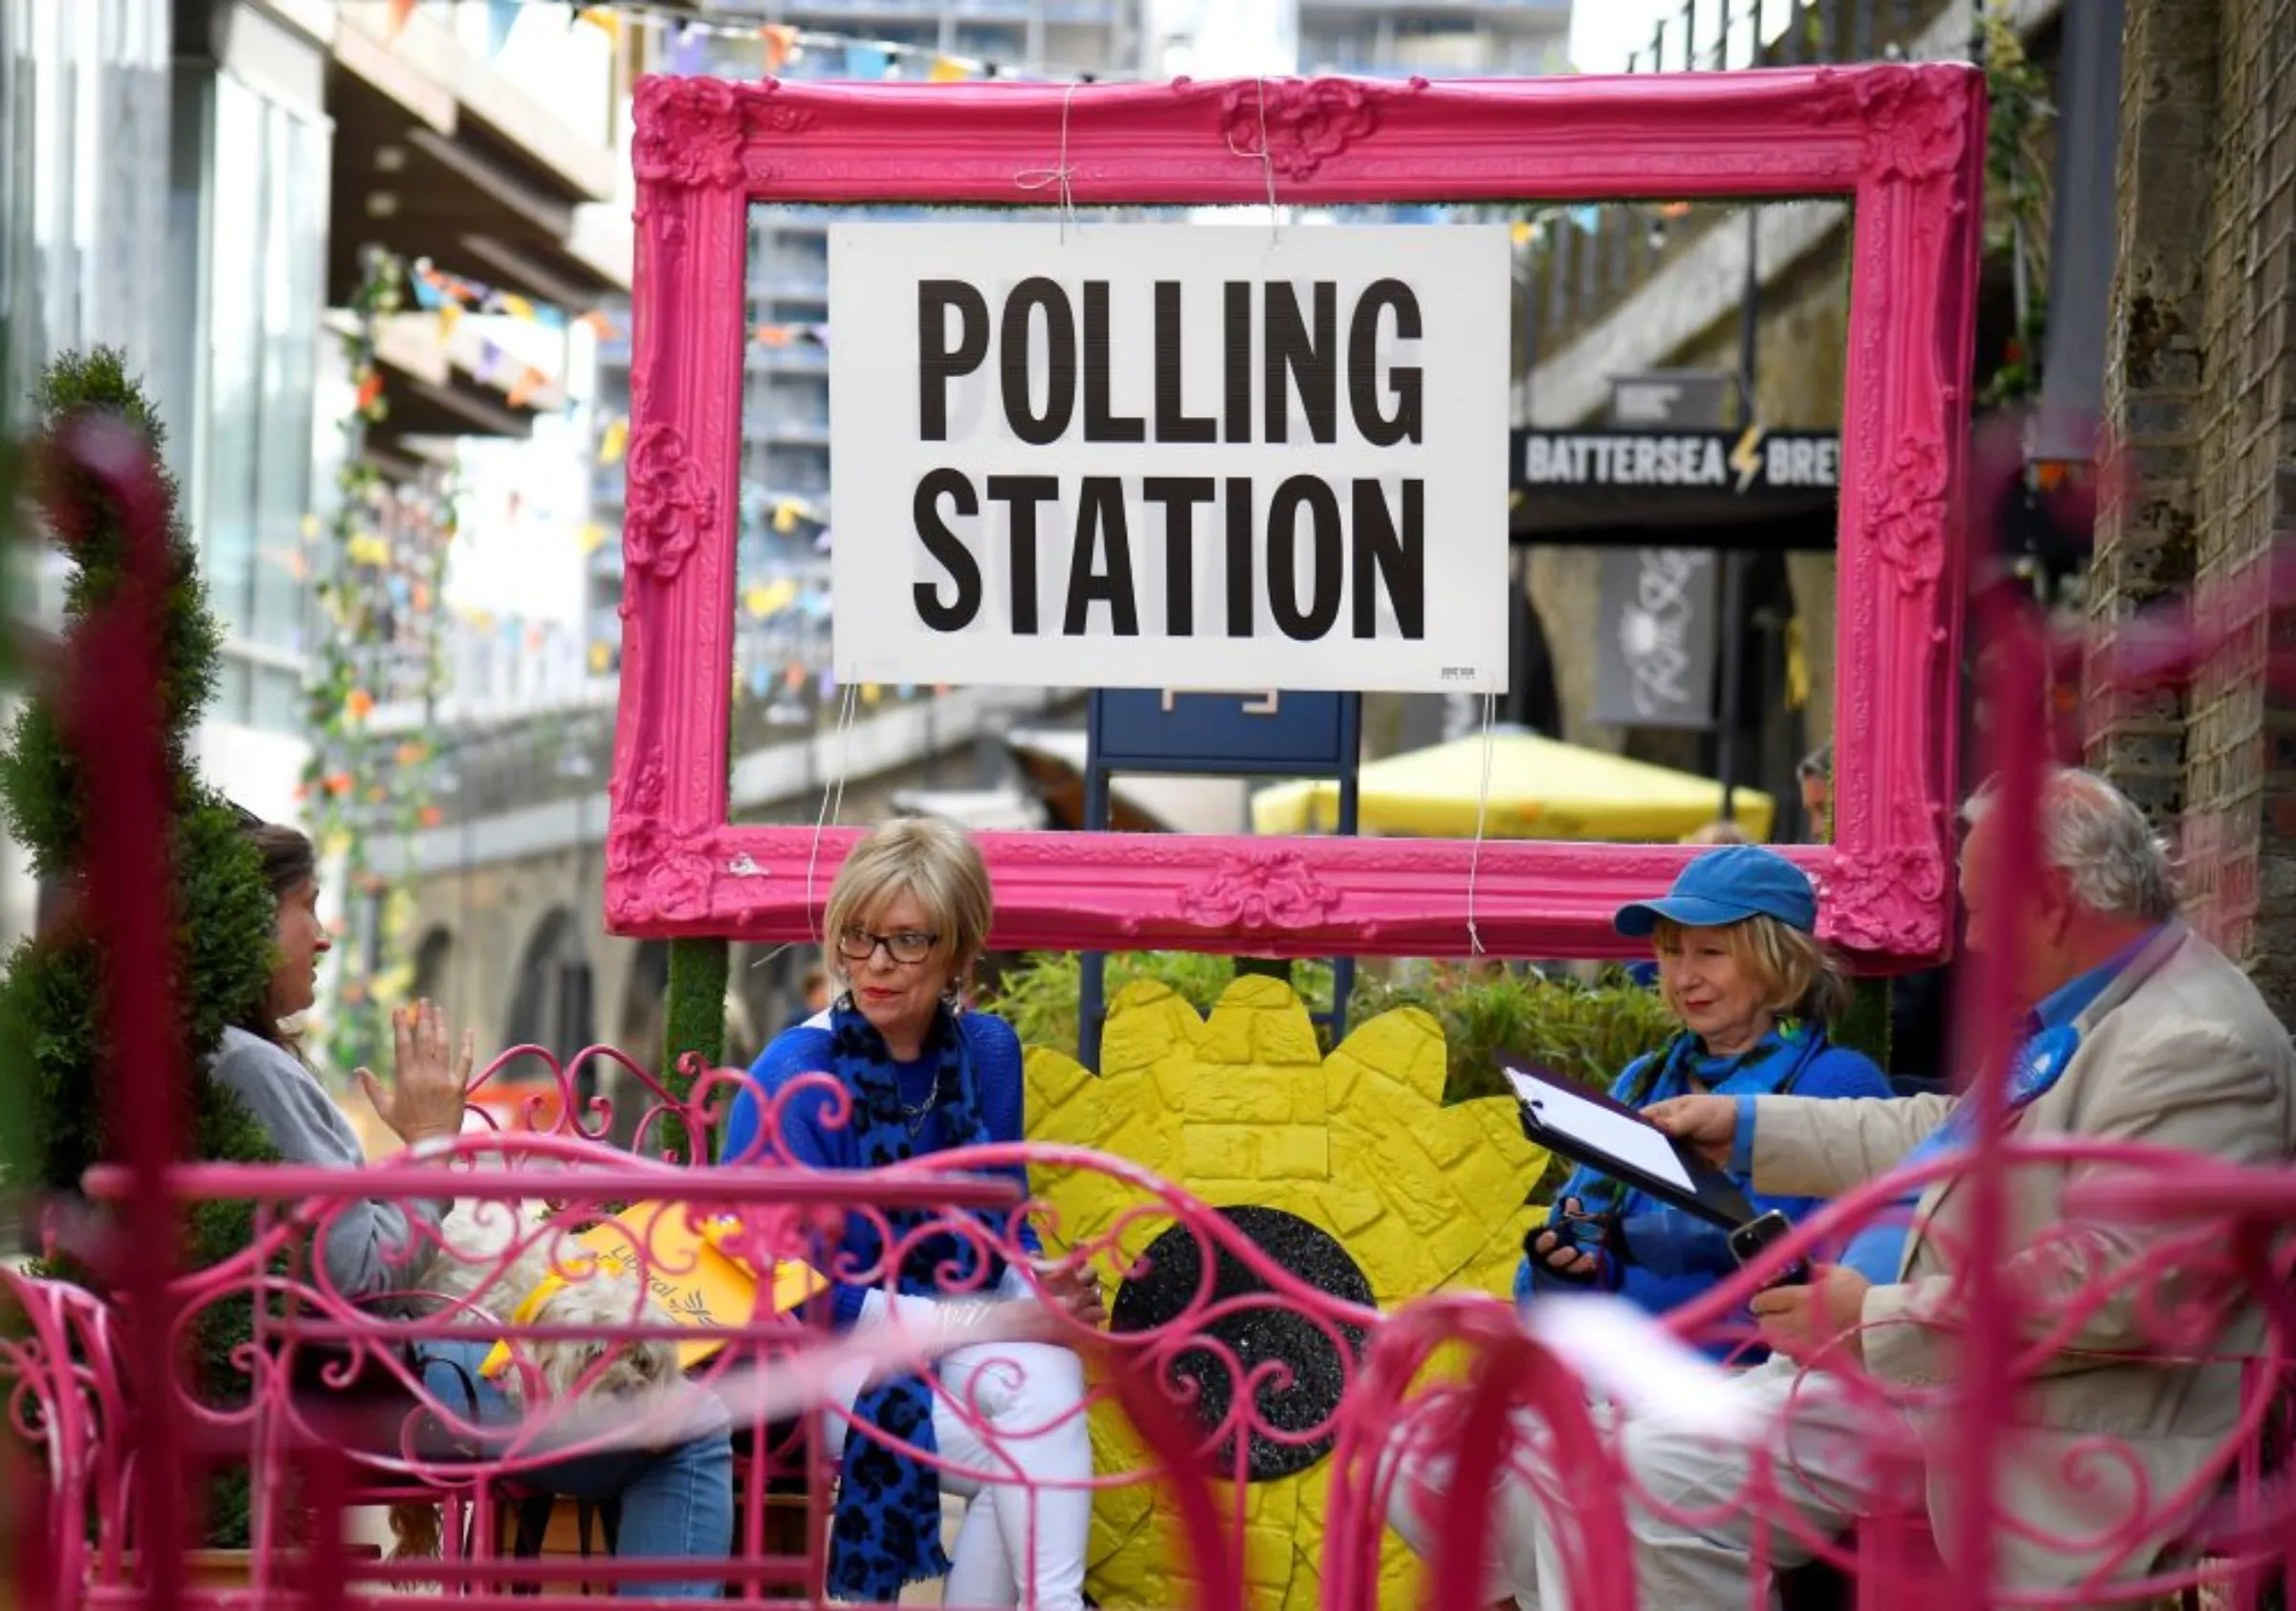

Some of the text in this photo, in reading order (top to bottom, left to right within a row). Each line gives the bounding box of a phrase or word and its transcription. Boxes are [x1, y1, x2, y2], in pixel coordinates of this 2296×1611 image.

[917, 276, 1423, 447] POLLING
[1526, 436, 1840, 485] BATTERSEA BRE
[913, 467, 1424, 641] STATION
[609, 1245, 678, 1299] Libral
